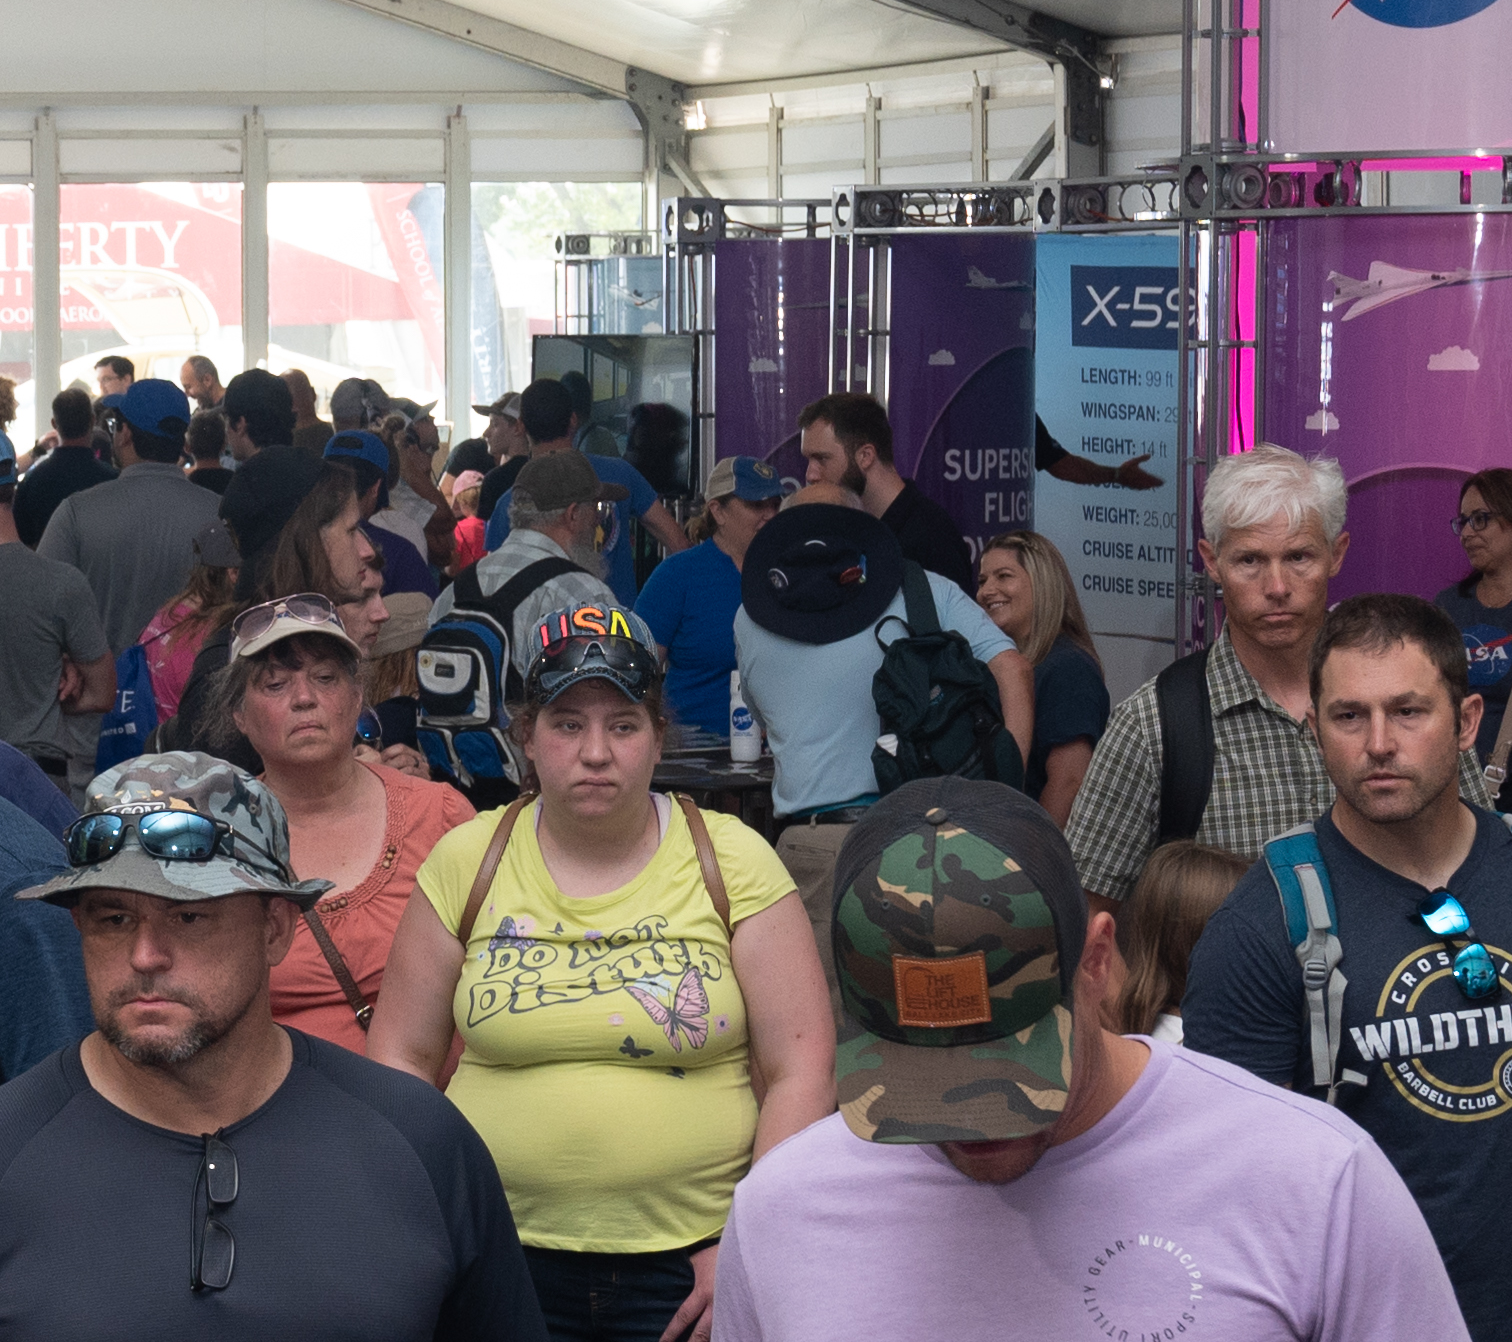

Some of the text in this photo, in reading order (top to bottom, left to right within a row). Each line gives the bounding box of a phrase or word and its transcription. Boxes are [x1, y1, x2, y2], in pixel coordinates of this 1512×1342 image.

[1081, 367, 1141, 386] LENGTH:
[1146, 370, 1161, 387] 99
[1081, 402, 1160, 422] WINGSPAN:
[1082, 437, 1136, 456] HEIGHT:
[1082, 505, 1139, 526] WEIGHT:
[1082, 539, 1133, 560] CRUISE
[1082, 574, 1175, 599] CRUISE SPEE
[540, 606, 633, 652] USA
[1397, 1061, 1497, 1110] BARBELL CLUB
[1088, 1240, 1126, 1276] GEAR
[1138, 1234, 1204, 1301] MUNICIPAL
[1083, 1285, 1129, 1342] UTILITY
